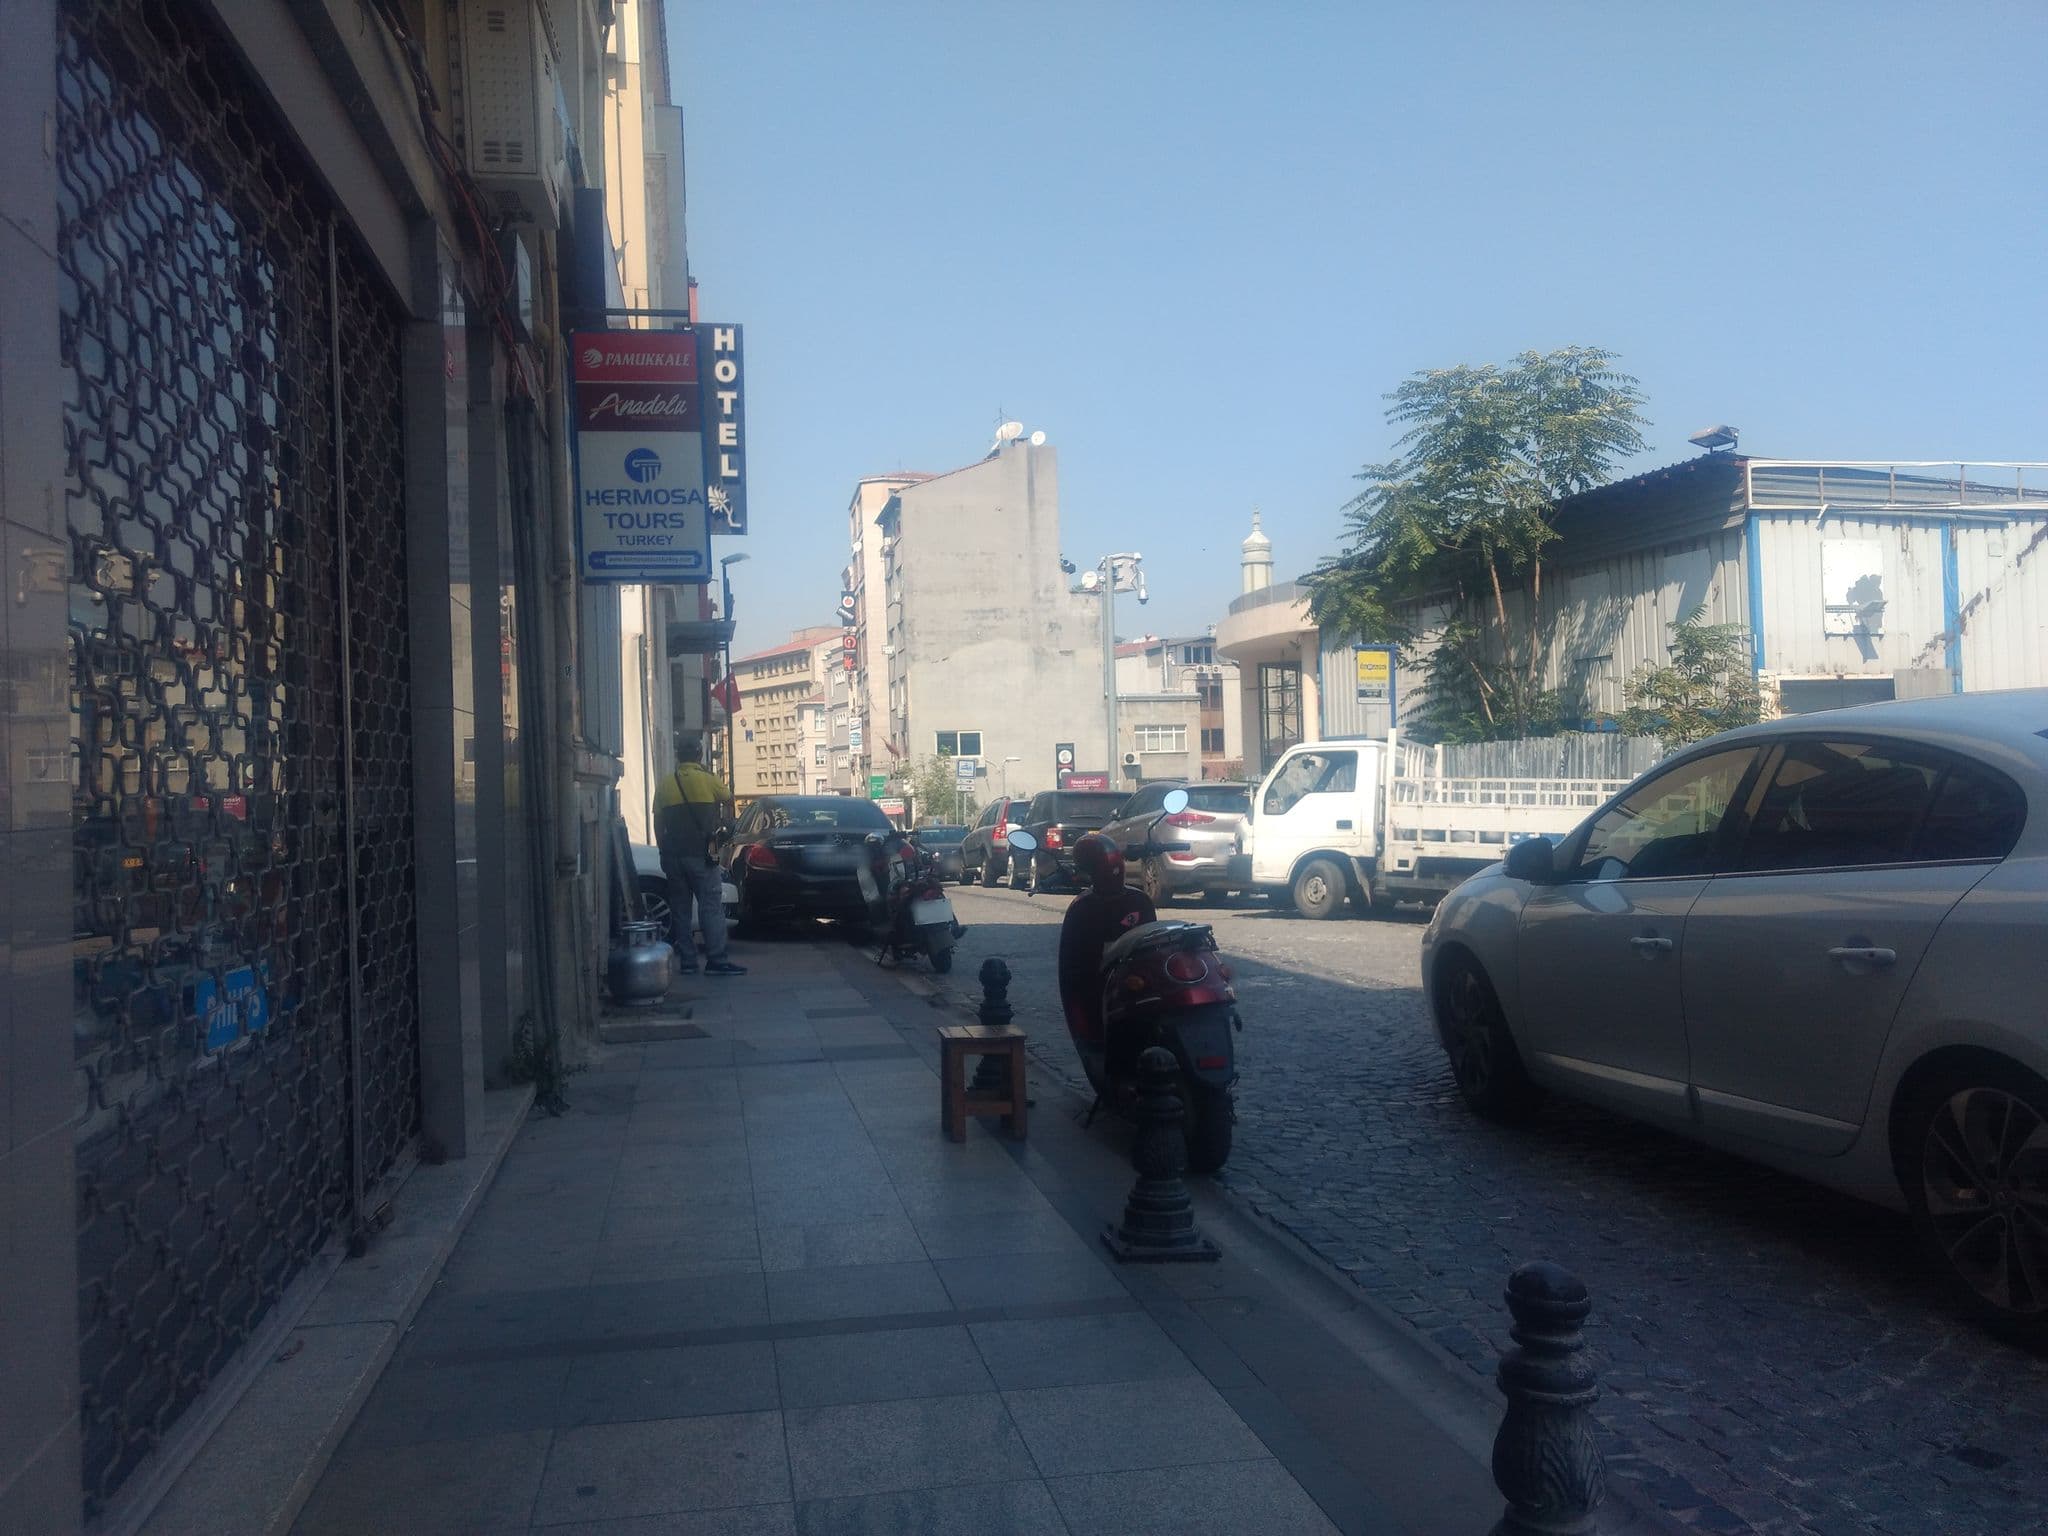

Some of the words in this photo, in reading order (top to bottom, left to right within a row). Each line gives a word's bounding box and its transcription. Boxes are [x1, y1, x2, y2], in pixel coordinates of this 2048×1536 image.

[606, 352, 691, 367] PAMUKKALE
[589, 393, 688, 421] Anadolu
[714, 328, 738, 477] HOTEL
[585, 488, 704, 506] HERMOSA
[604, 512, 685, 530] TOURS
[616, 535, 674, 546] TURKEY
